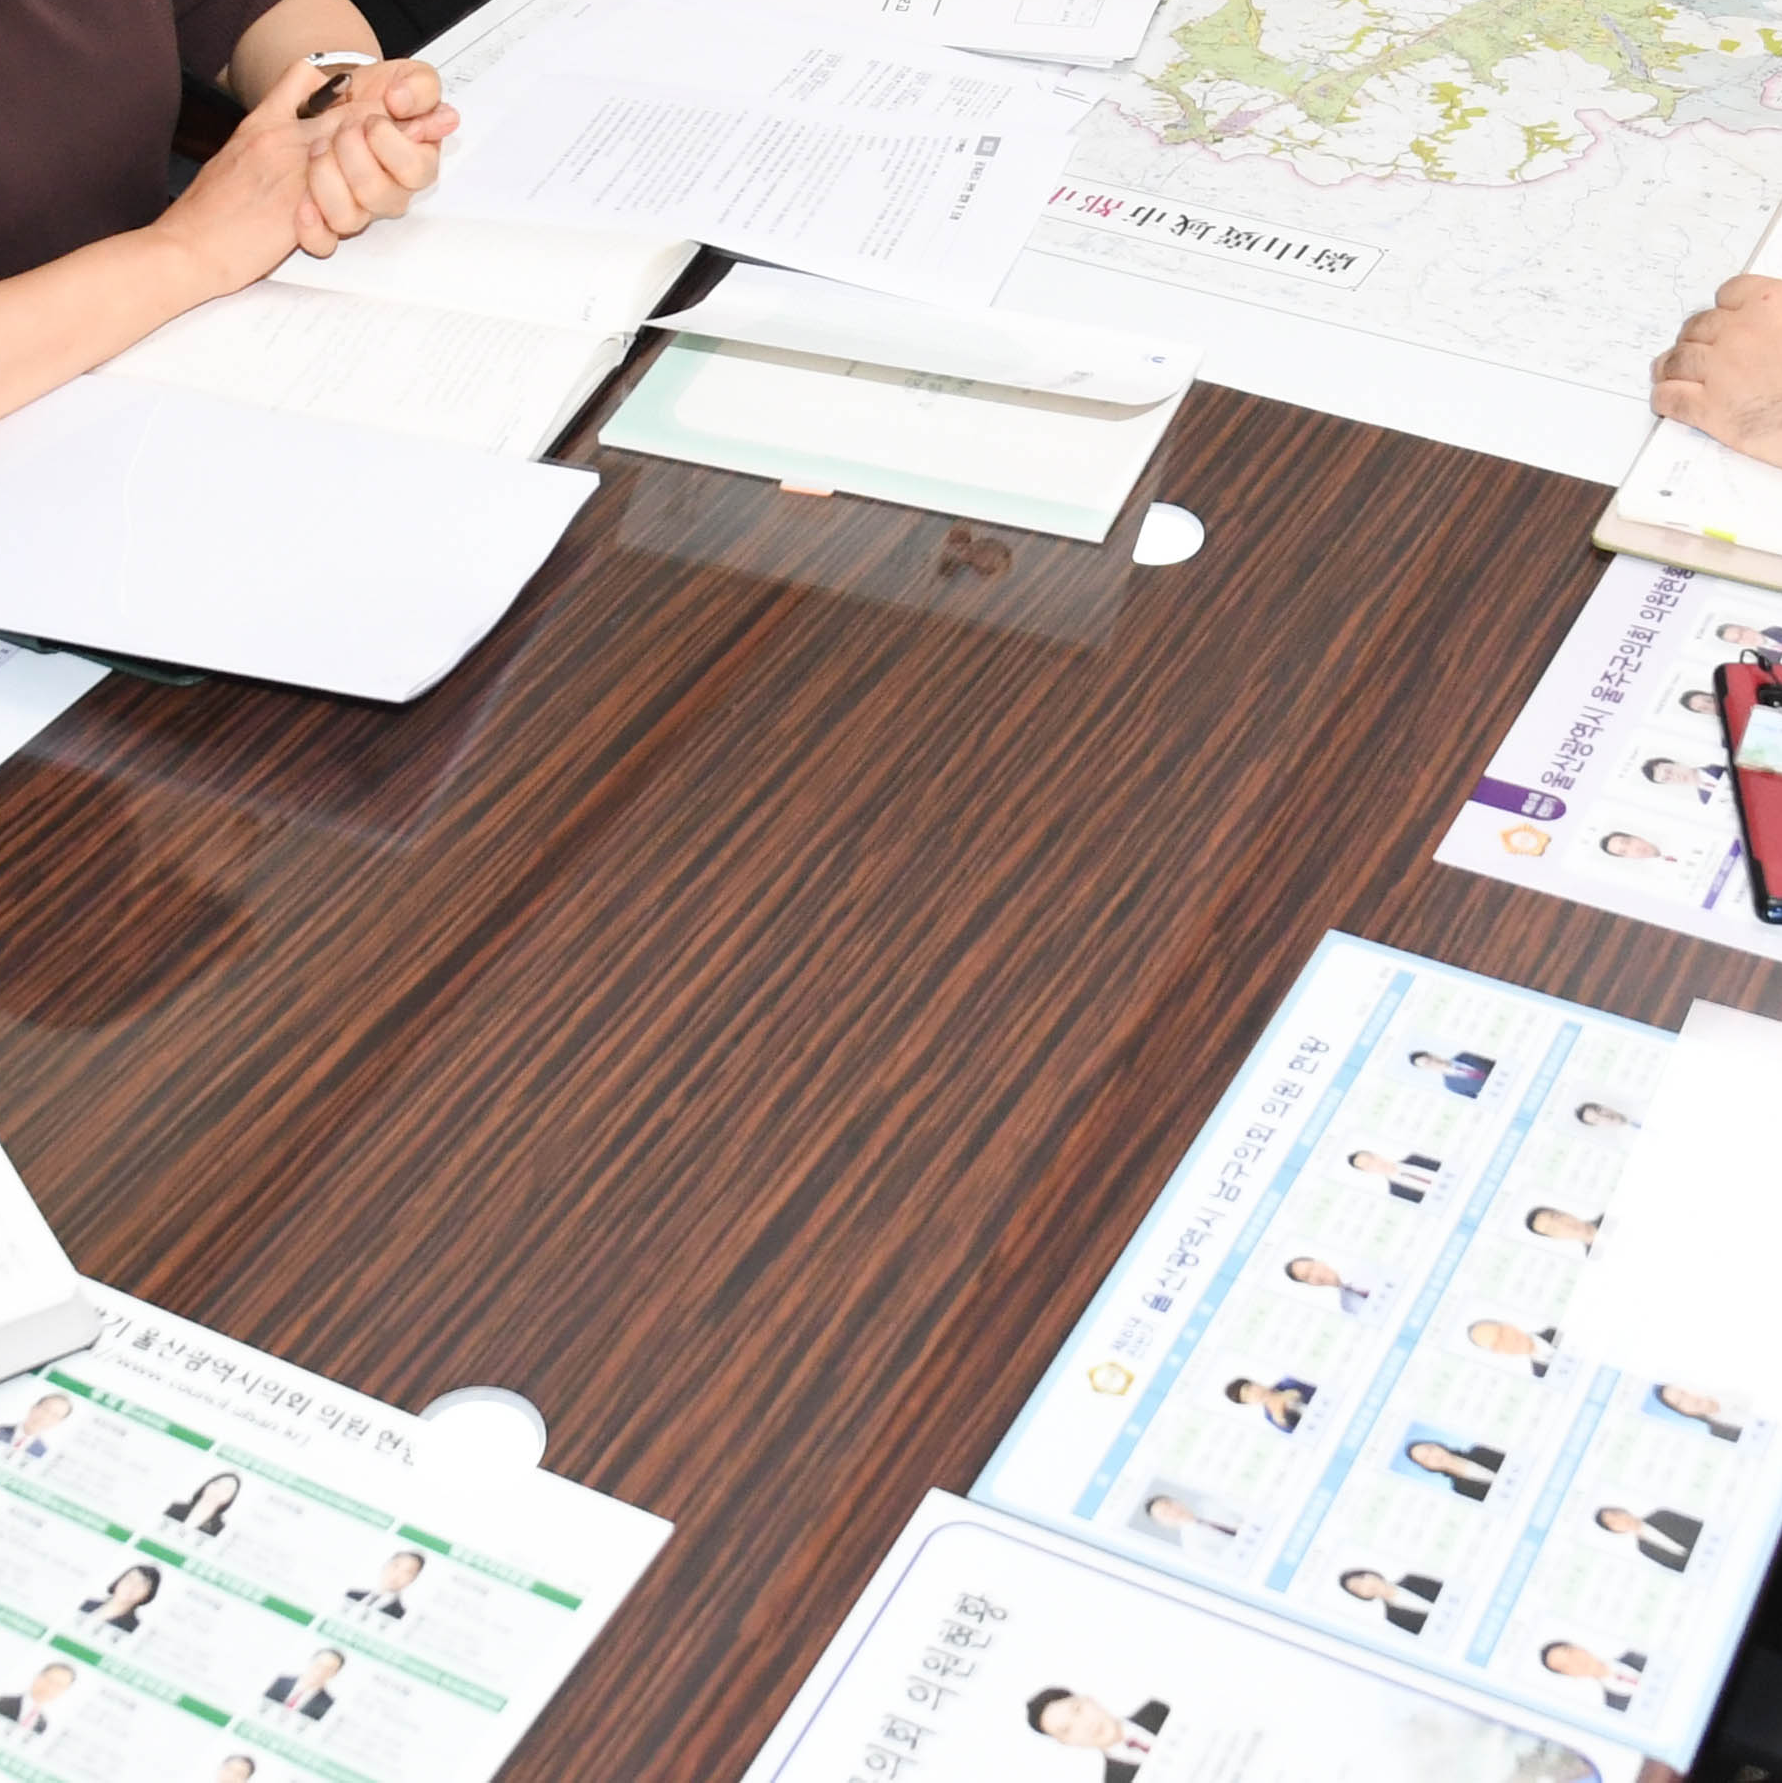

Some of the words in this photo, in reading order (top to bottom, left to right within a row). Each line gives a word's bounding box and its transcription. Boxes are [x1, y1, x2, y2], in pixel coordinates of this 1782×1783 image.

[1541, 706, 1613, 790] 울산광역시
[1591, 625, 1659, 703] 울주군의회
[1640, 559, 1698, 622] 의원현황
[1142, 1208, 1227, 1314] 울산광역시
[1209, 1123, 1276, 1202] 남구의회
[1262, 1080, 1304, 1118] 의원
[1288, 1036, 1329, 1074] 현황
[132, 1329, 312, 1416] 울산광역시의회
[320, 1406, 370, 1440] 의원
[849, 1714, 934, 1783] 의회
[908, 1593, 1008, 1711] 의원현황
